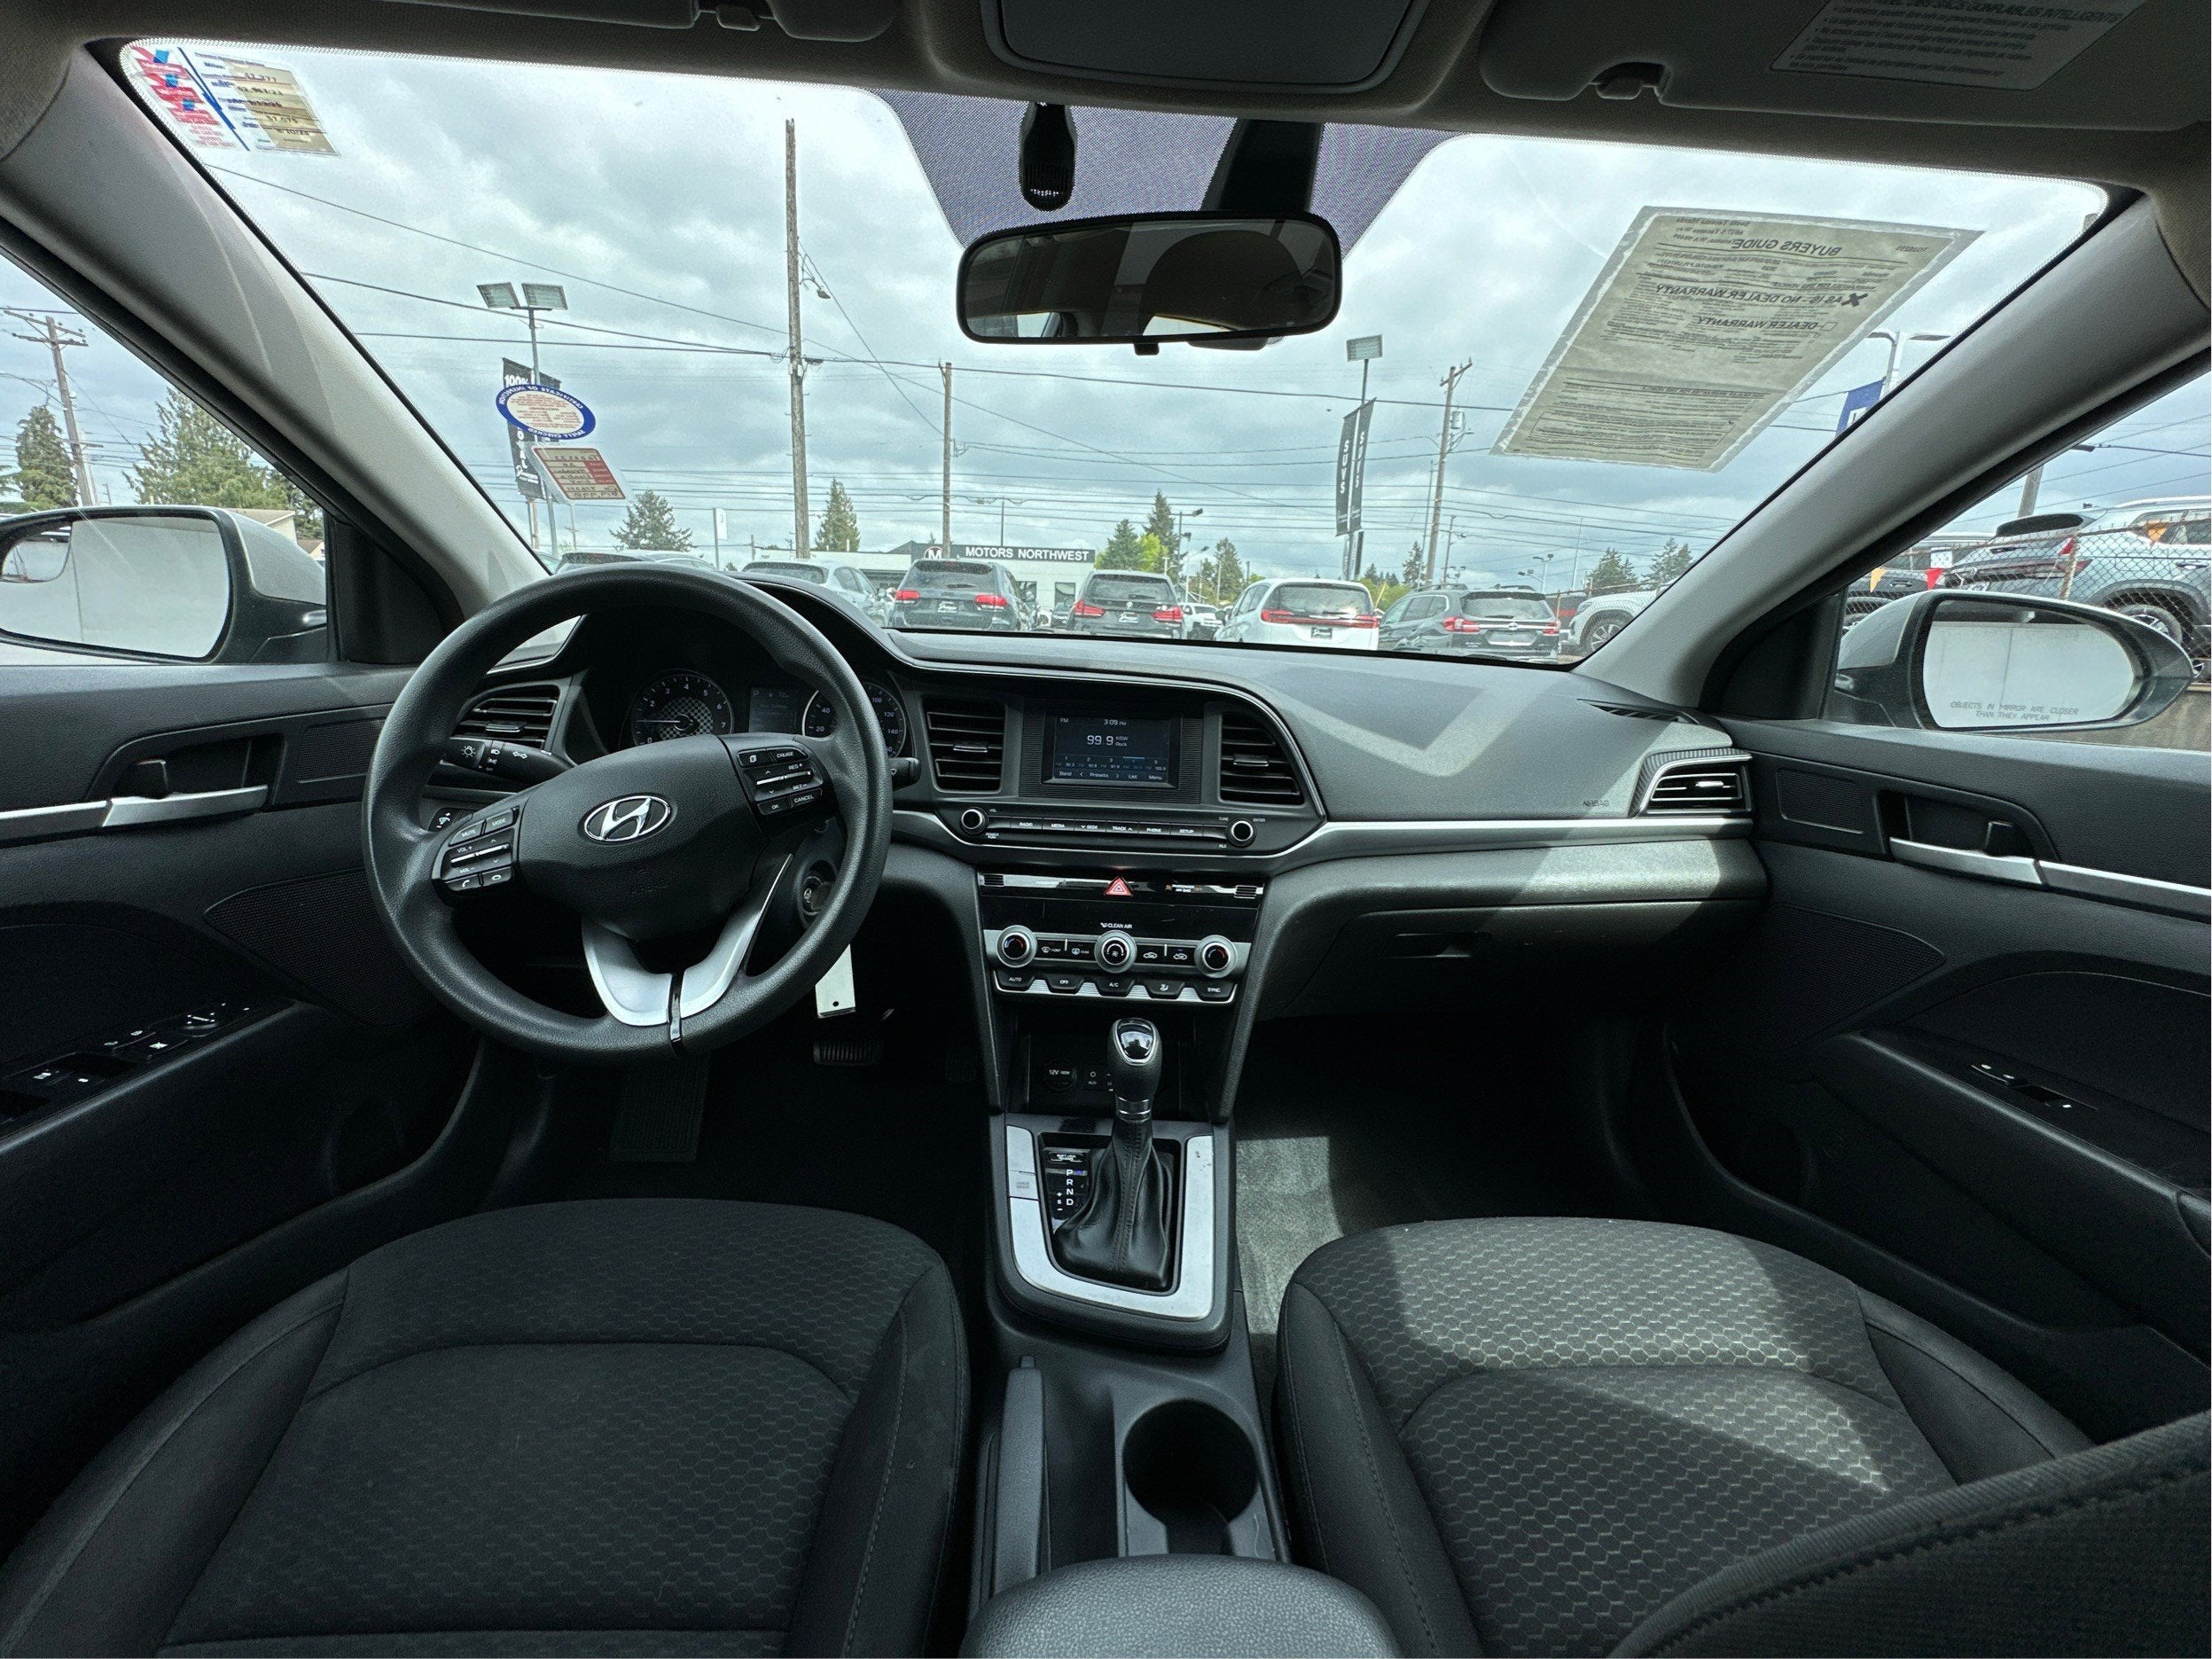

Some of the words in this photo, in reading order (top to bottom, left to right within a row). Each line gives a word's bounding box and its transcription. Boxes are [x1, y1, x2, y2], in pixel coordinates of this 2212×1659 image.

[1340, 440, 1349, 494] SUVS
[965, 546, 1014, 559] MOTORS
[1018, 549, 1090, 561] NORTHWEST
[1950, 701, 1982, 710] OBJECTS
[1999, 703, 2027, 712] MIRROR
[2050, 707, 2080, 716] CLOSER
[2021, 713, 2050, 722] APPEAR
[1087, 735, 1114, 746] 99.9
[793, 794, 815, 803] CANCEL
